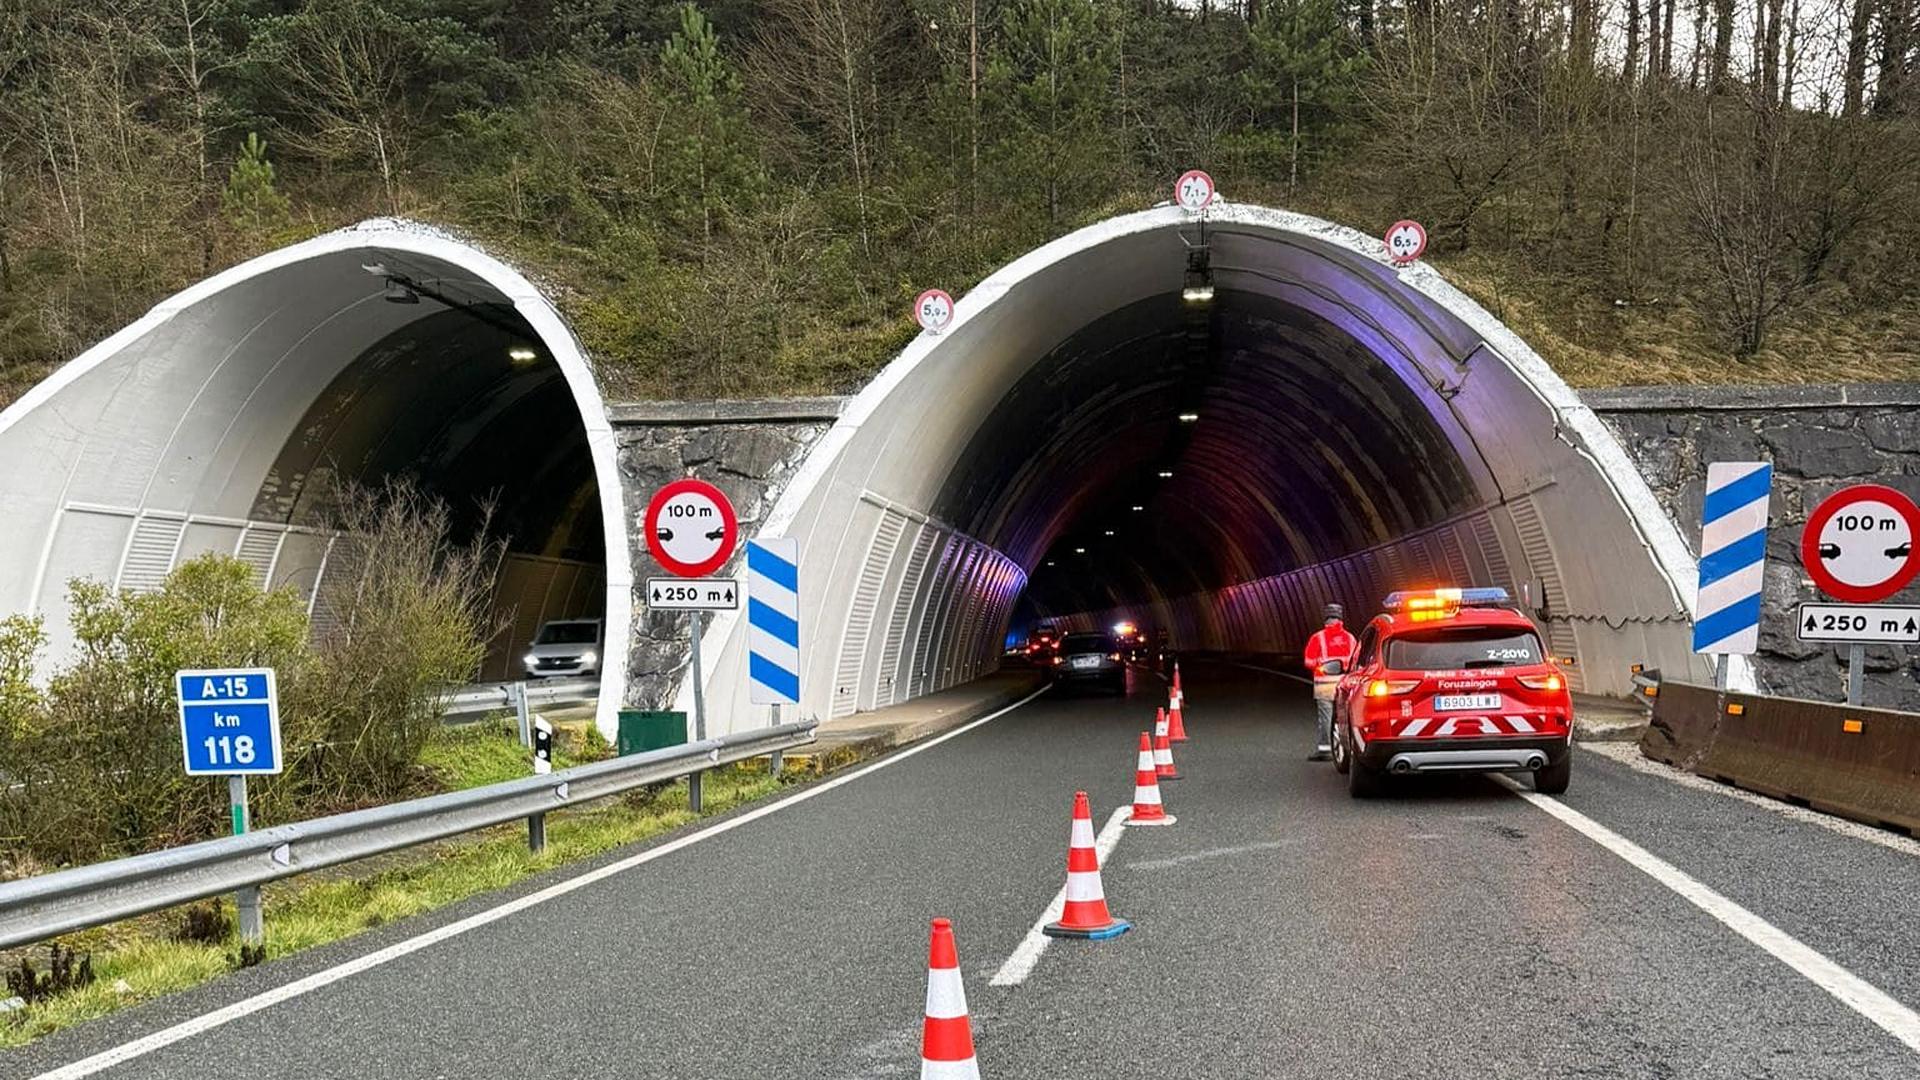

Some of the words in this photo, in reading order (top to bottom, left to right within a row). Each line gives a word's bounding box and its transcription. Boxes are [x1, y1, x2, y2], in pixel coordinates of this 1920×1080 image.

[667, 504, 695, 517] 100
[699, 507, 712, 517] m
[1836, 515, 1874, 531] 100
[1879, 519, 1896, 530] m
[665, 587, 698, 601] 250
[707, 590, 720, 601] m
[1823, 615, 1867, 631] 250
[1881, 621, 1898, 632] m
[1487, 649, 1530, 659] Z-2010
[202, 677, 248, 698] A-15
[1438, 680, 1498, 689] Foruzaingoa
[1444, 696, 1473, 708] 6903
[214, 711, 240, 727] km
[204, 735, 255, 764] 118
